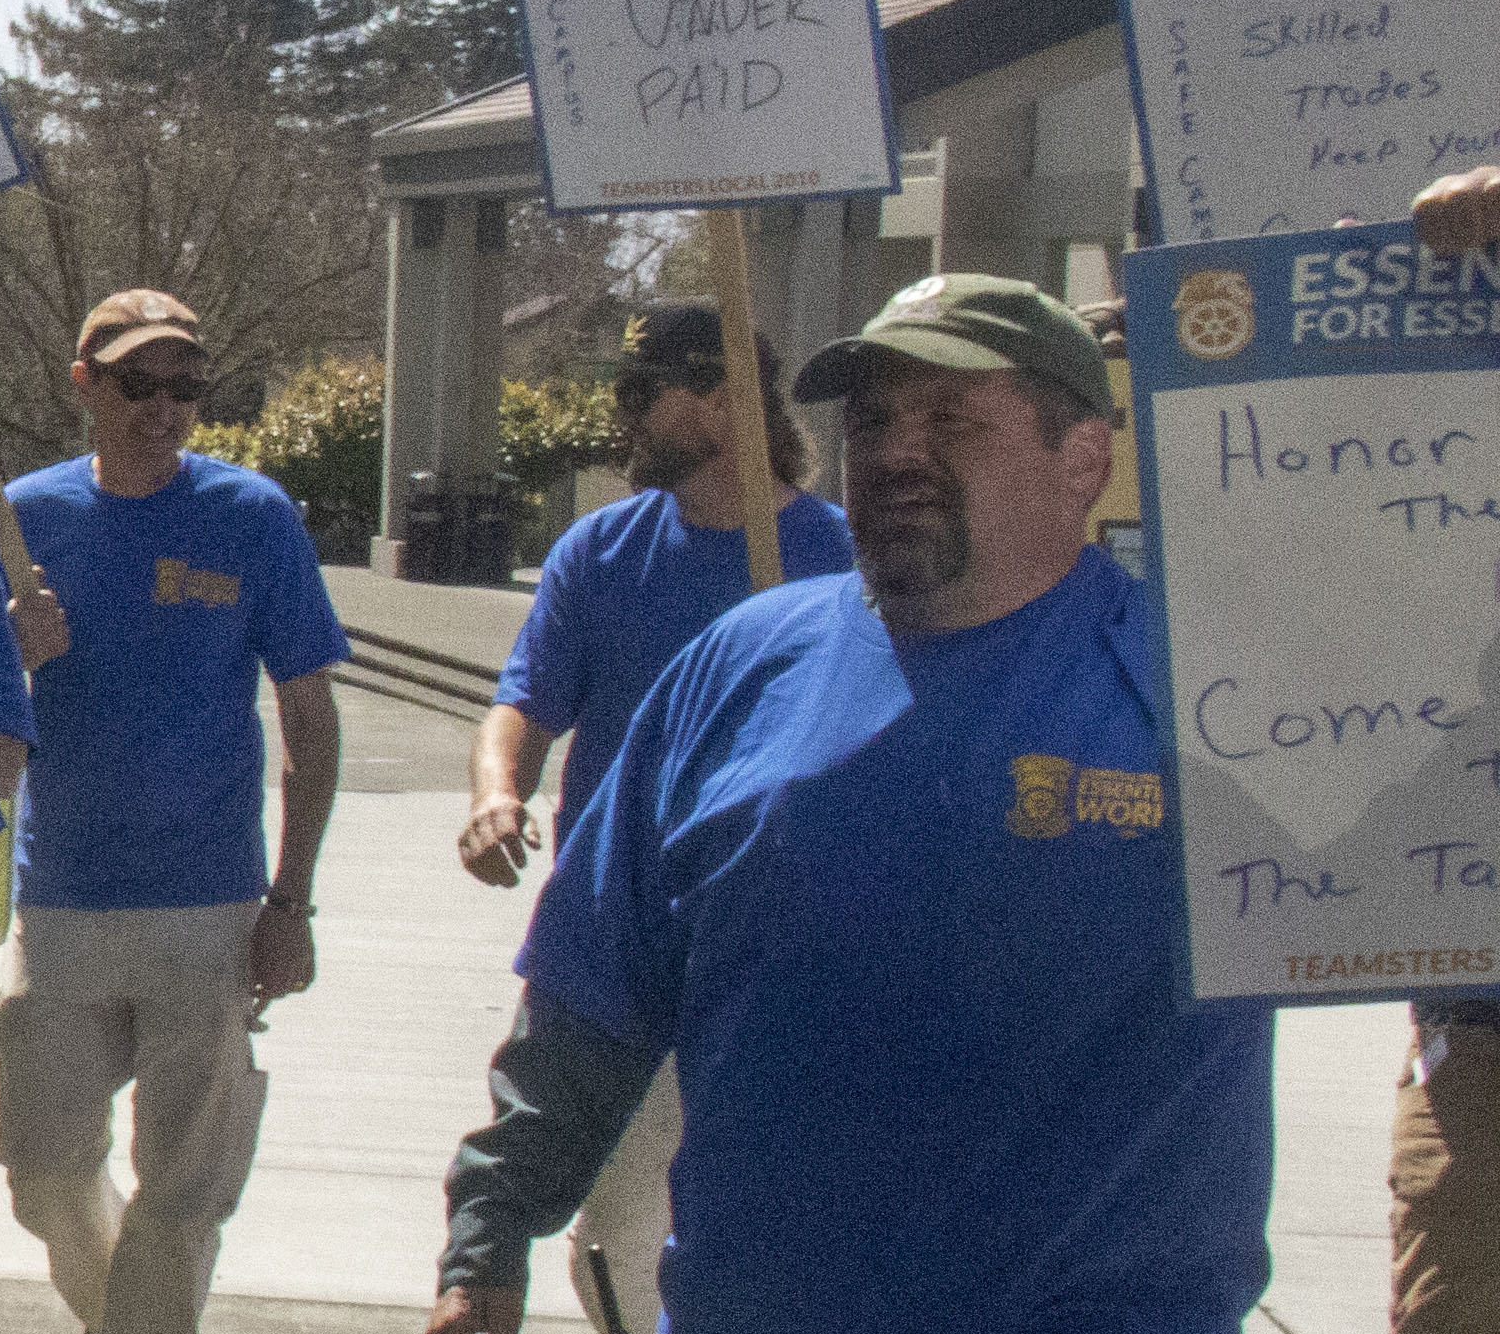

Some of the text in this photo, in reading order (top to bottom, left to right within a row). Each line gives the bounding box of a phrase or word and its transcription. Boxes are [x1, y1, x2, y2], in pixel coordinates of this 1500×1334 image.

[1240, 4, 1391, 59] Skilled
[636, 59, 785, 126] PAID
[1168, 19, 1195, 137] SAFE
[599, 169, 822, 199] TEAMSTERS LOCAL 2010
[1292, 301, 1393, 344] FOR
[1218, 403, 1478, 493] Honor
[1195, 676, 1468, 760] Come
[1220, 856, 1360, 921] The
[1282, 947, 1496, 983] TEAMSTERS
